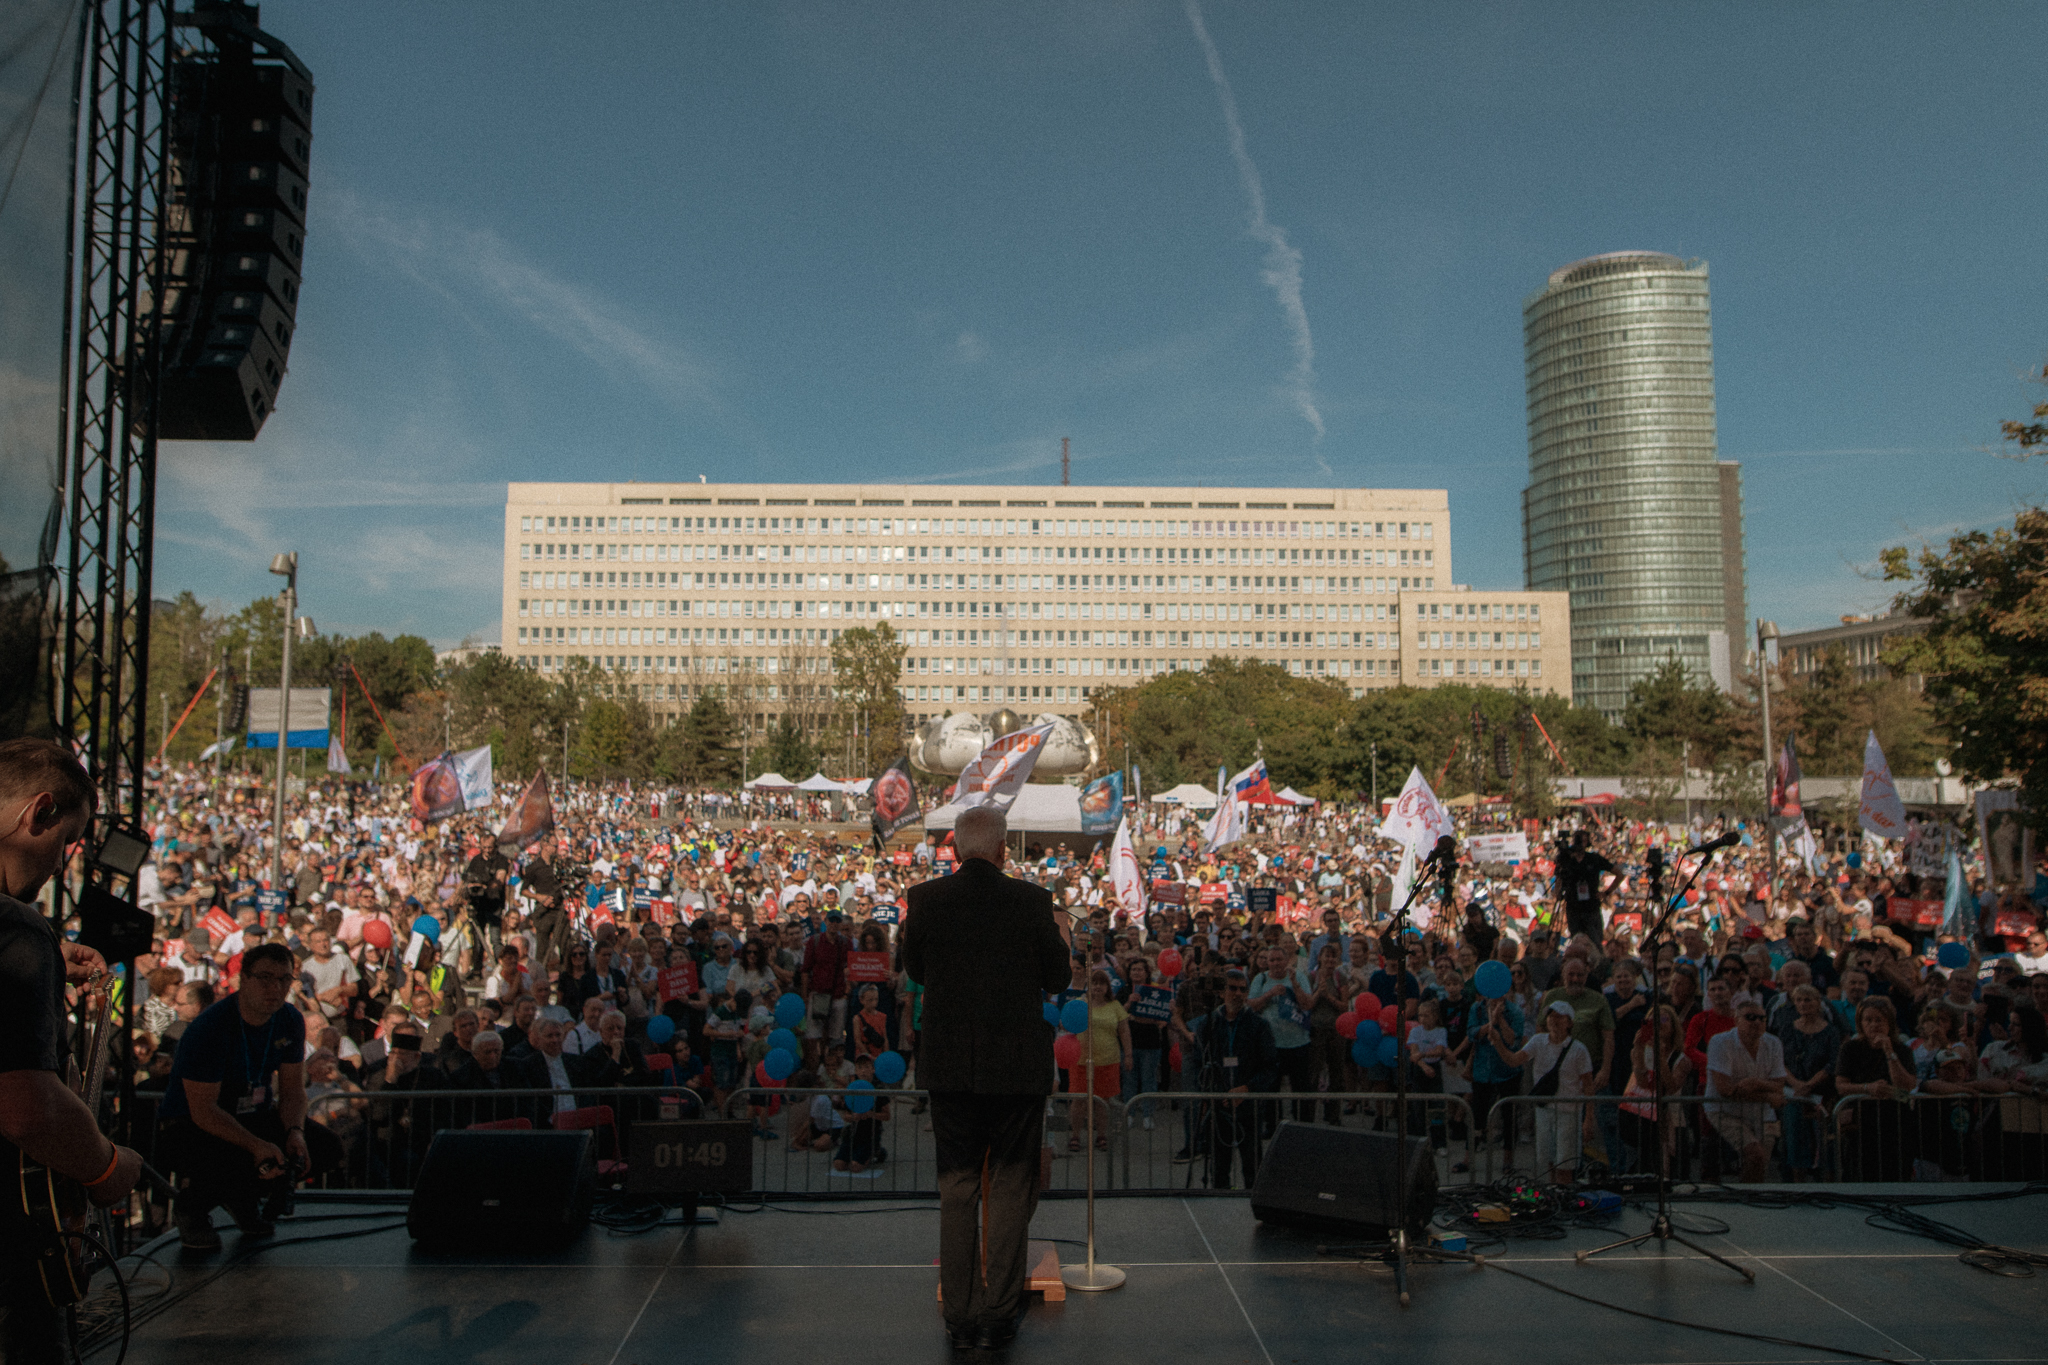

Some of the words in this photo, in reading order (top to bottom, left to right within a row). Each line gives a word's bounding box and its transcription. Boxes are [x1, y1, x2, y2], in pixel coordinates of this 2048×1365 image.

[665, 965, 690, 980] LÁSKA
[1136, 1005, 1147, 1013] ZA
[1148, 1006, 1171, 1019] ŽIVOT
[655, 1142, 726, 1168] 01:49
